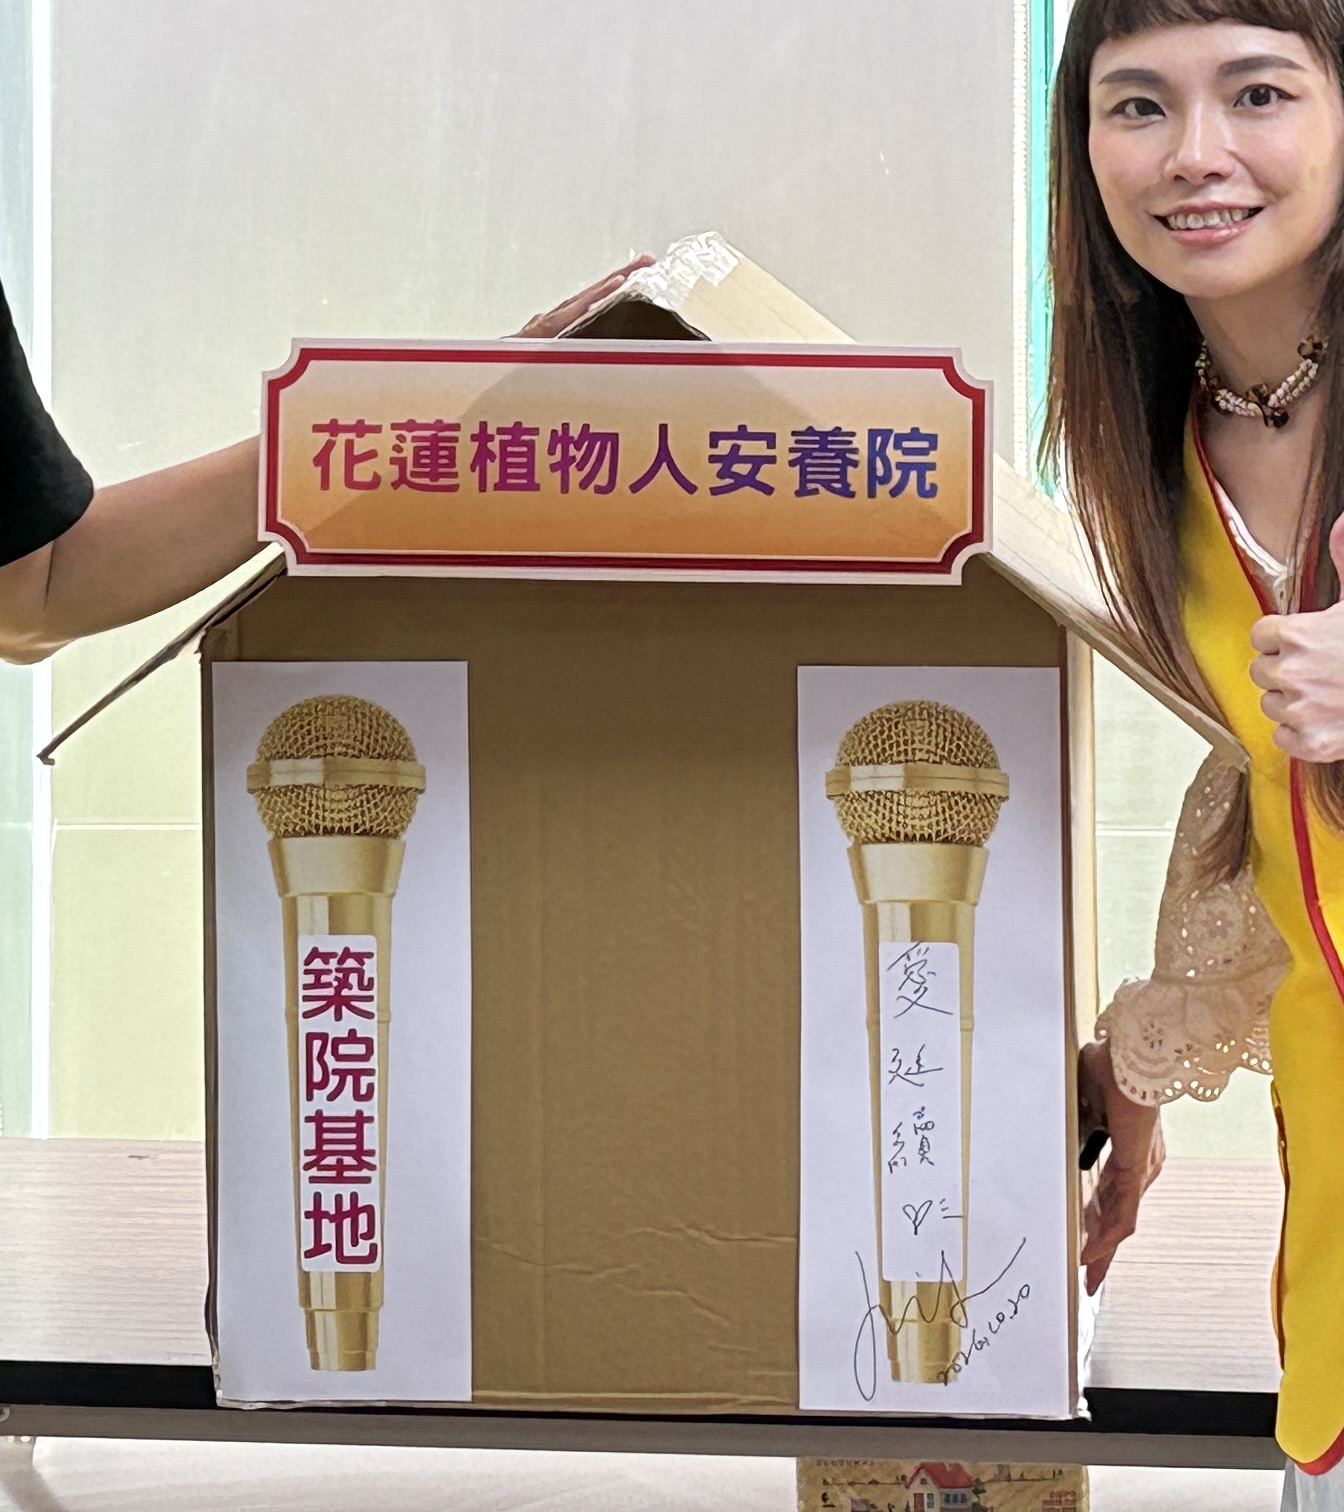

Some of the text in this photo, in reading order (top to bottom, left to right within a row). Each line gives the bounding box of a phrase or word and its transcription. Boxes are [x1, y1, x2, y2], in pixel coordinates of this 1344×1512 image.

[310, 417, 940, 500] 花蓮植物人安養院
[300, 944, 380, 1266] 築院基地
